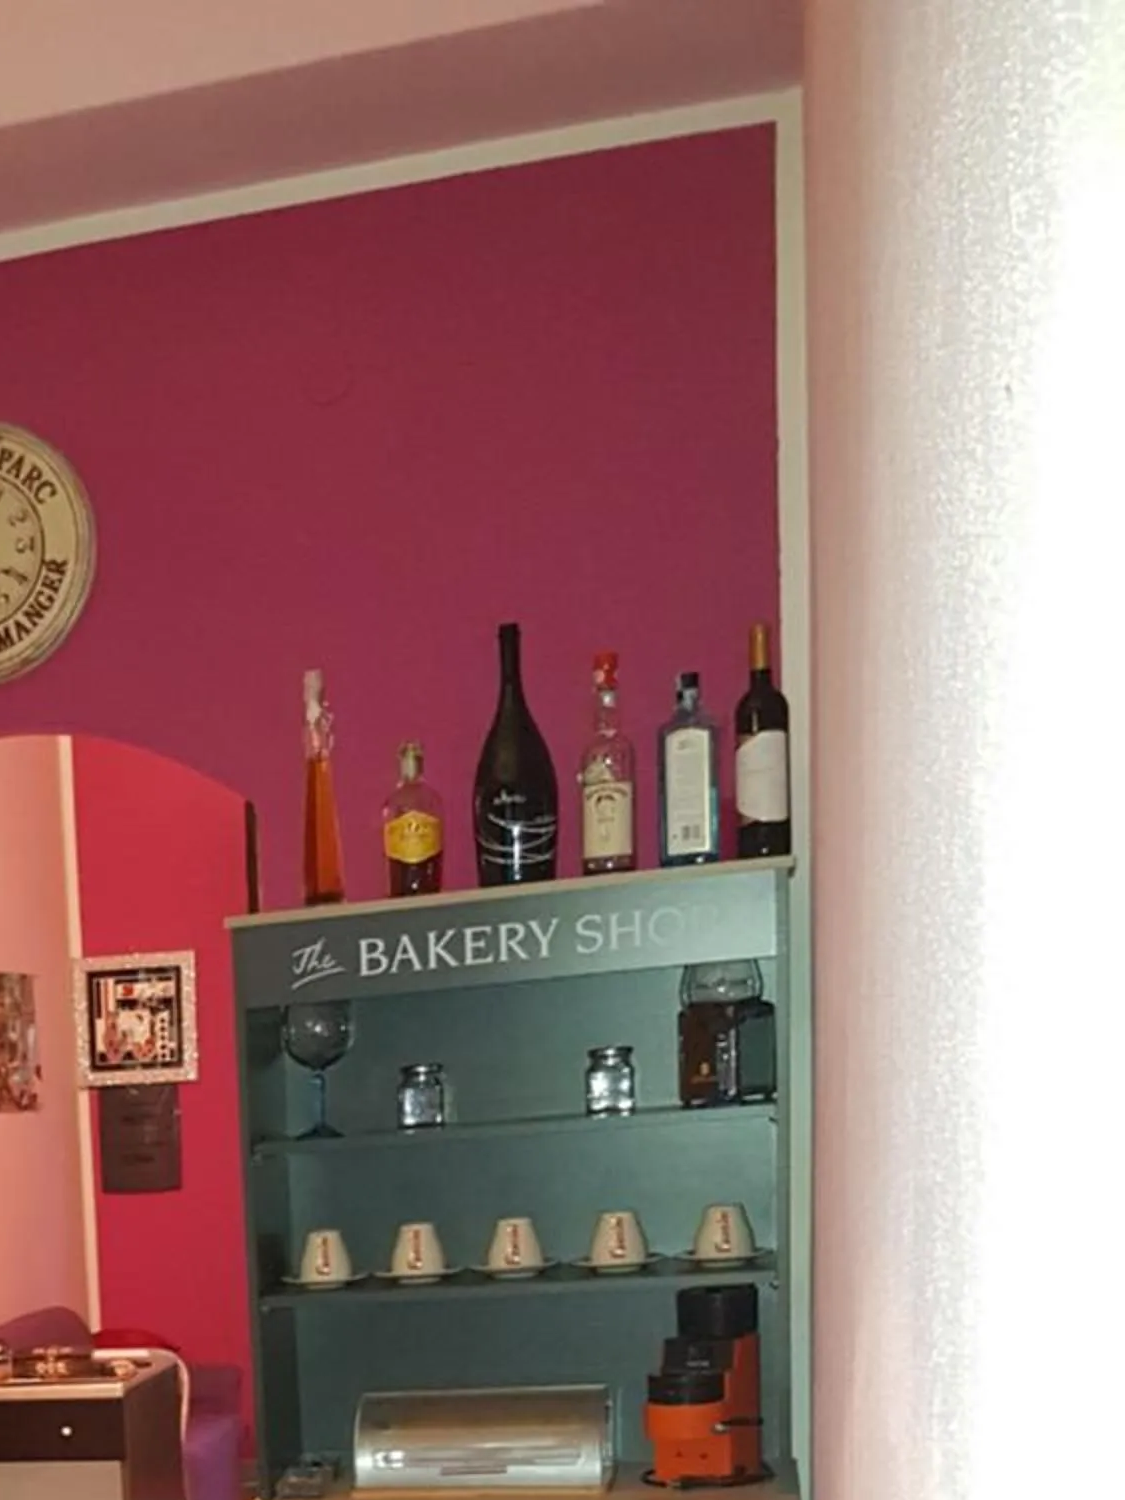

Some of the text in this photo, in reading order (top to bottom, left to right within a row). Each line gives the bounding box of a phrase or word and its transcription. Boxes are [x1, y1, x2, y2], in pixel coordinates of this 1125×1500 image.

[291, 902, 718, 981] The BAKERY SHO
